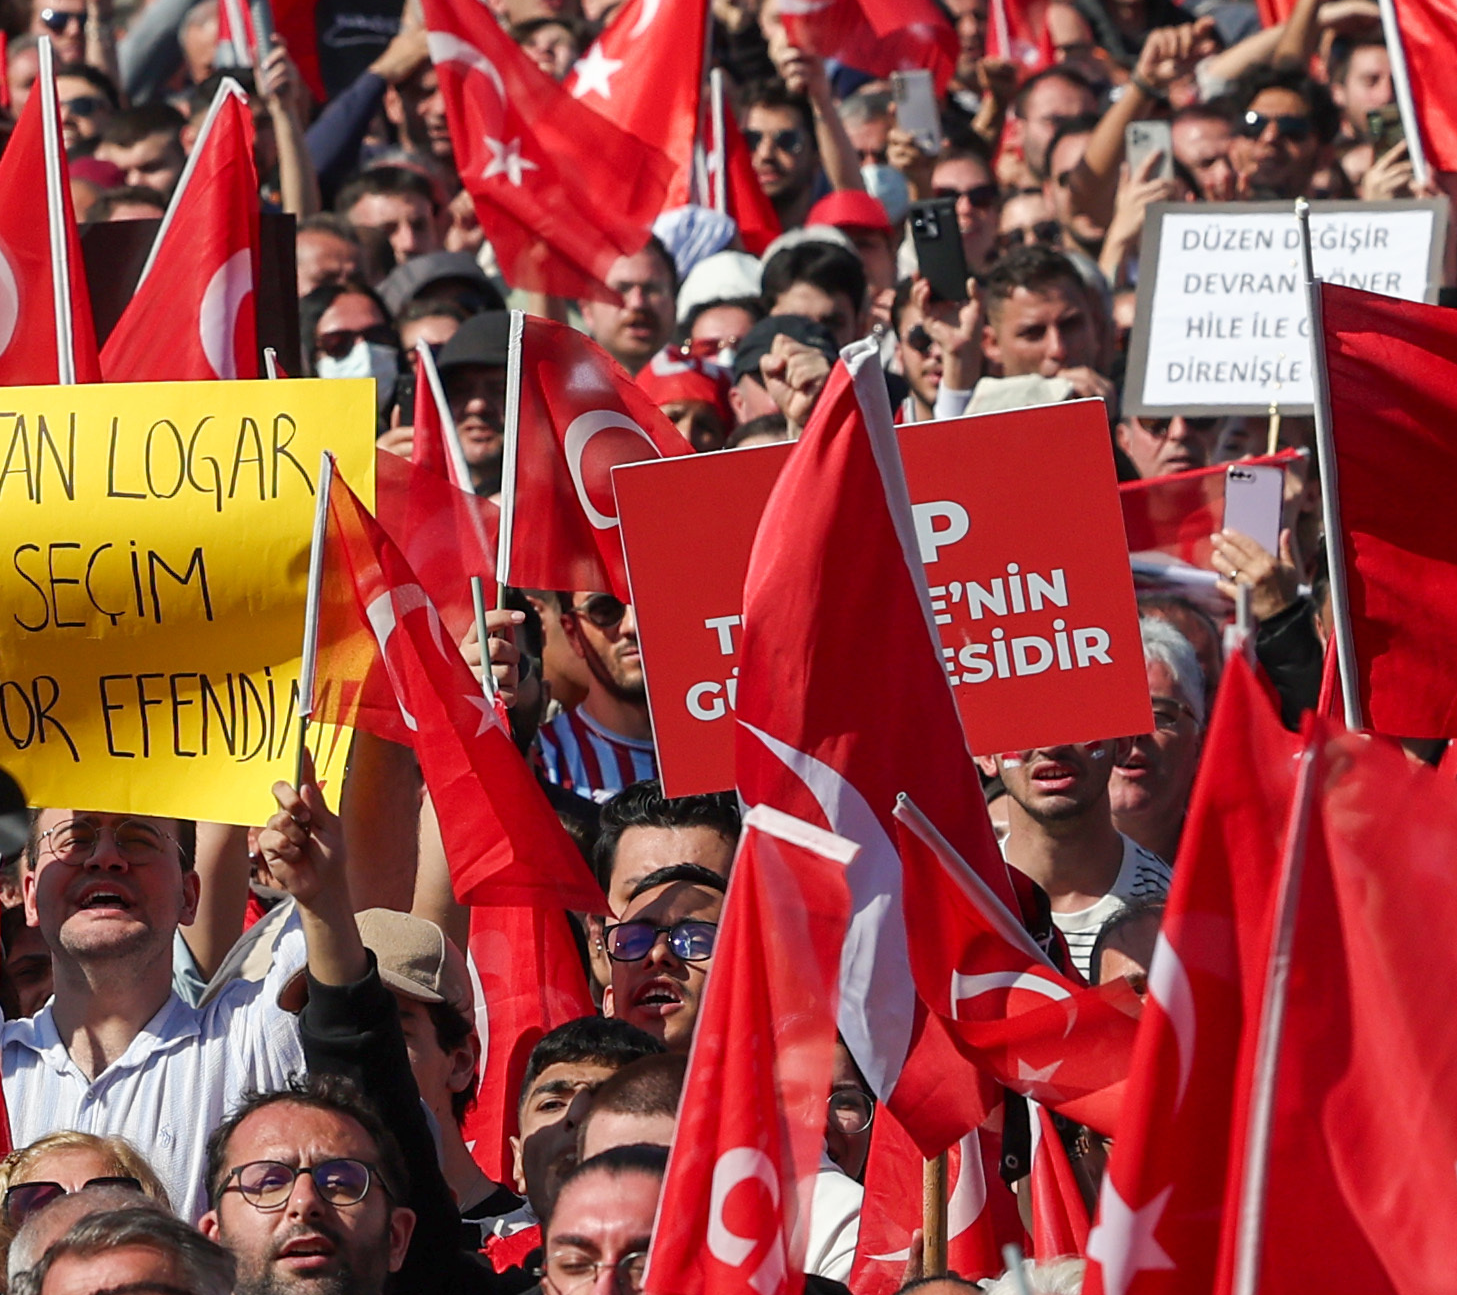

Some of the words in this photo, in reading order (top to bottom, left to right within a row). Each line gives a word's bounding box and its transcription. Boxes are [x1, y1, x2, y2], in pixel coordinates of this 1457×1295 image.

[1181, 223, 1274, 251] DÜZEN
[1183, 272, 1297, 294] DEVRAN
[1186, 310, 1243, 339] HİLE
[1251, 310, 1289, 339] İLE
[1167, 355, 1303, 388] DİRENİŞLE
[106, 412, 316, 509] LOGAR
[13, 539, 214, 632] SEÇİM
